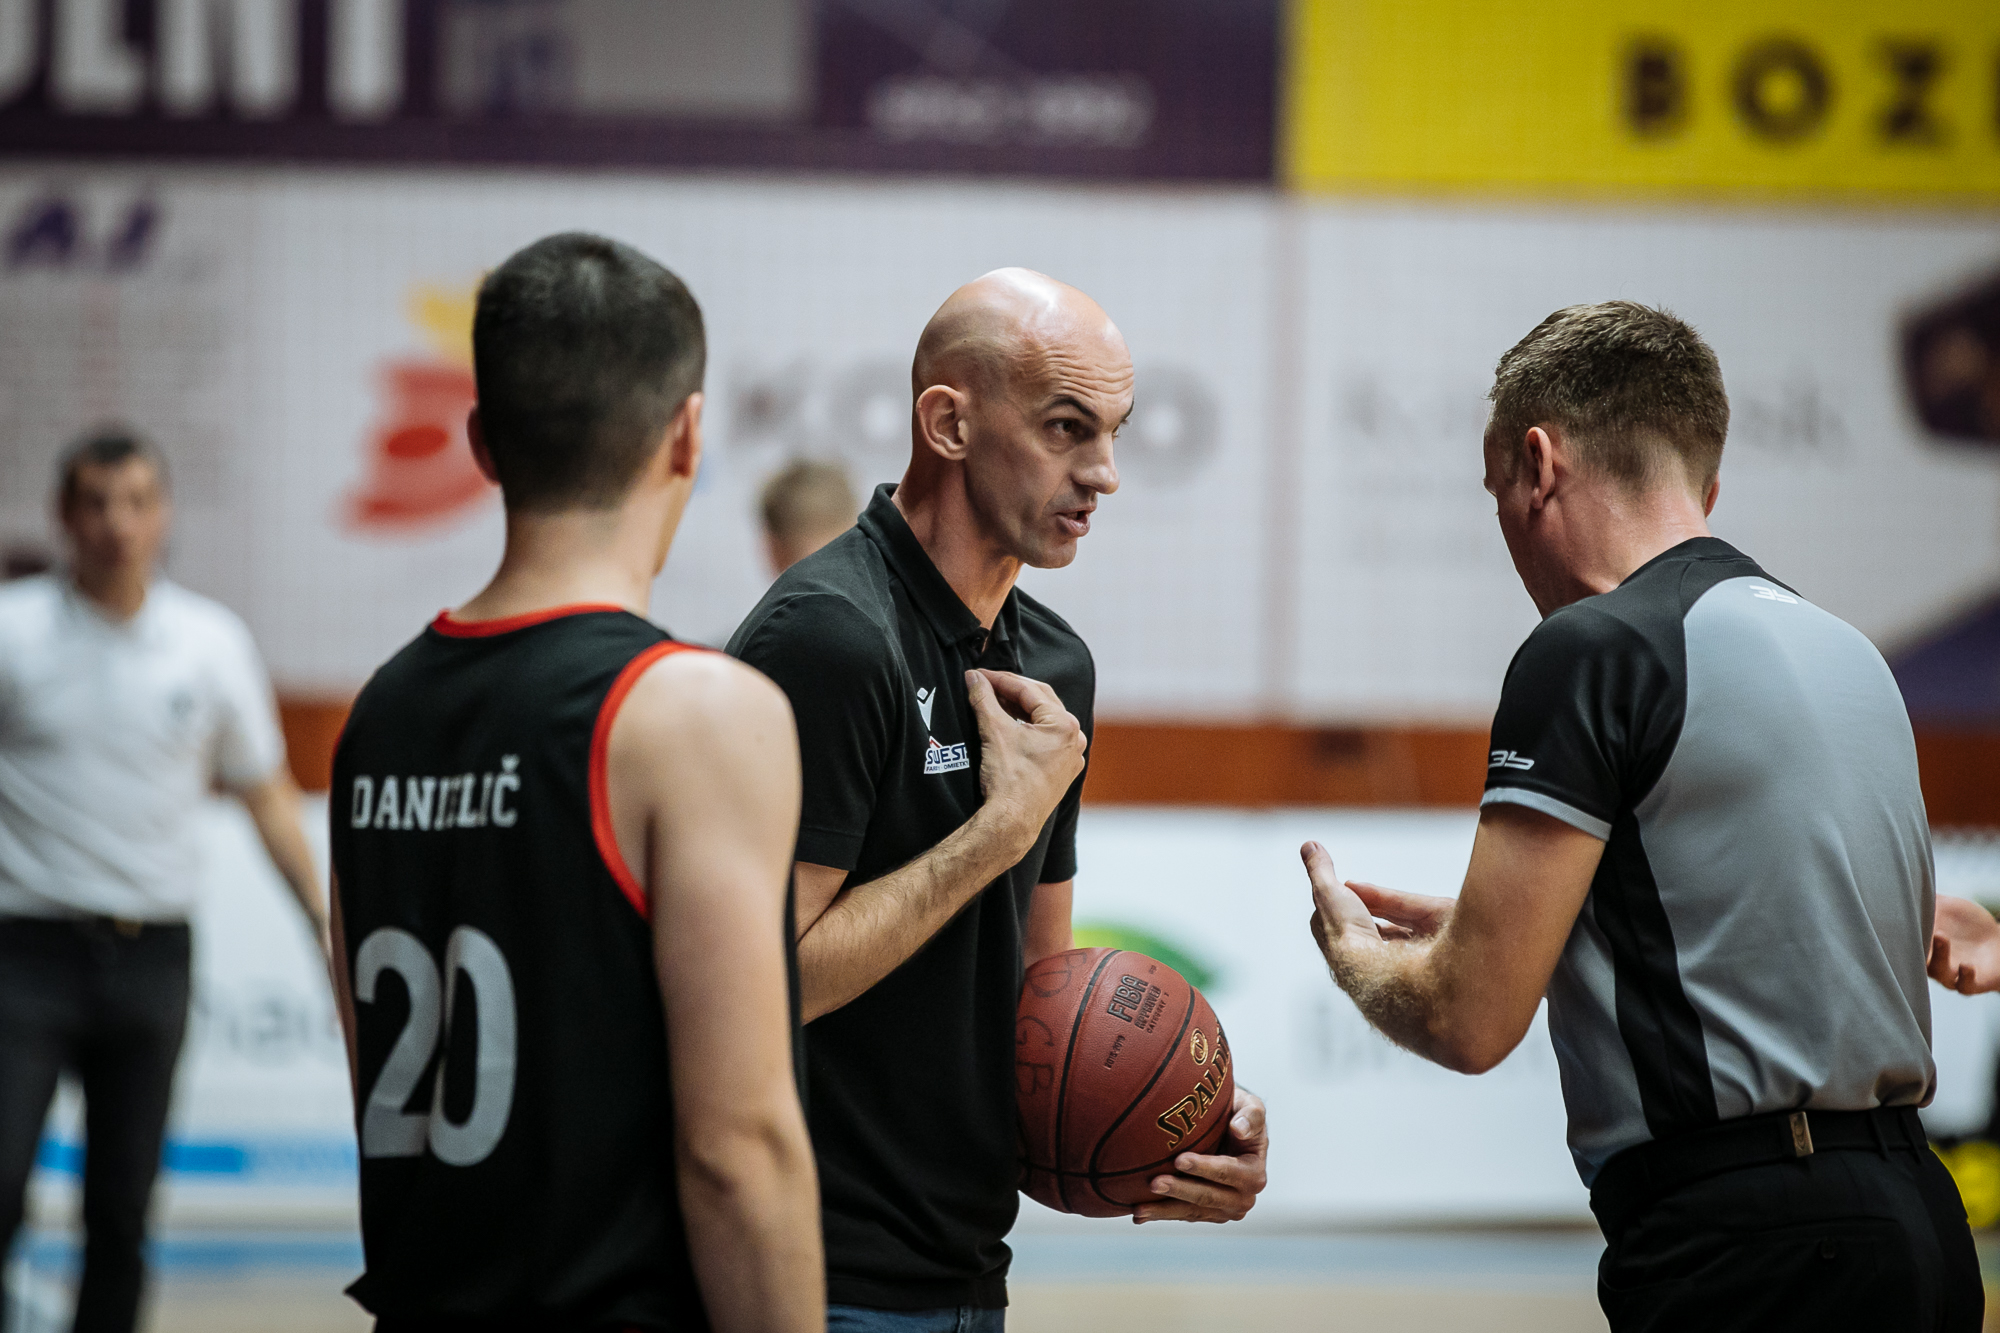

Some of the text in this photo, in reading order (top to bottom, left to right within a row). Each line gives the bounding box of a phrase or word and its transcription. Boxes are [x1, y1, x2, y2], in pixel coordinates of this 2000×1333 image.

[1614, 26, 2000, 154] BOZ
[1107, 974, 1149, 1023] FIBA
[1134, 985, 1161, 1030] APPROVED
[1146, 1000, 1167, 1034] CATEGORY
[356, 924, 517, 1167] 20
